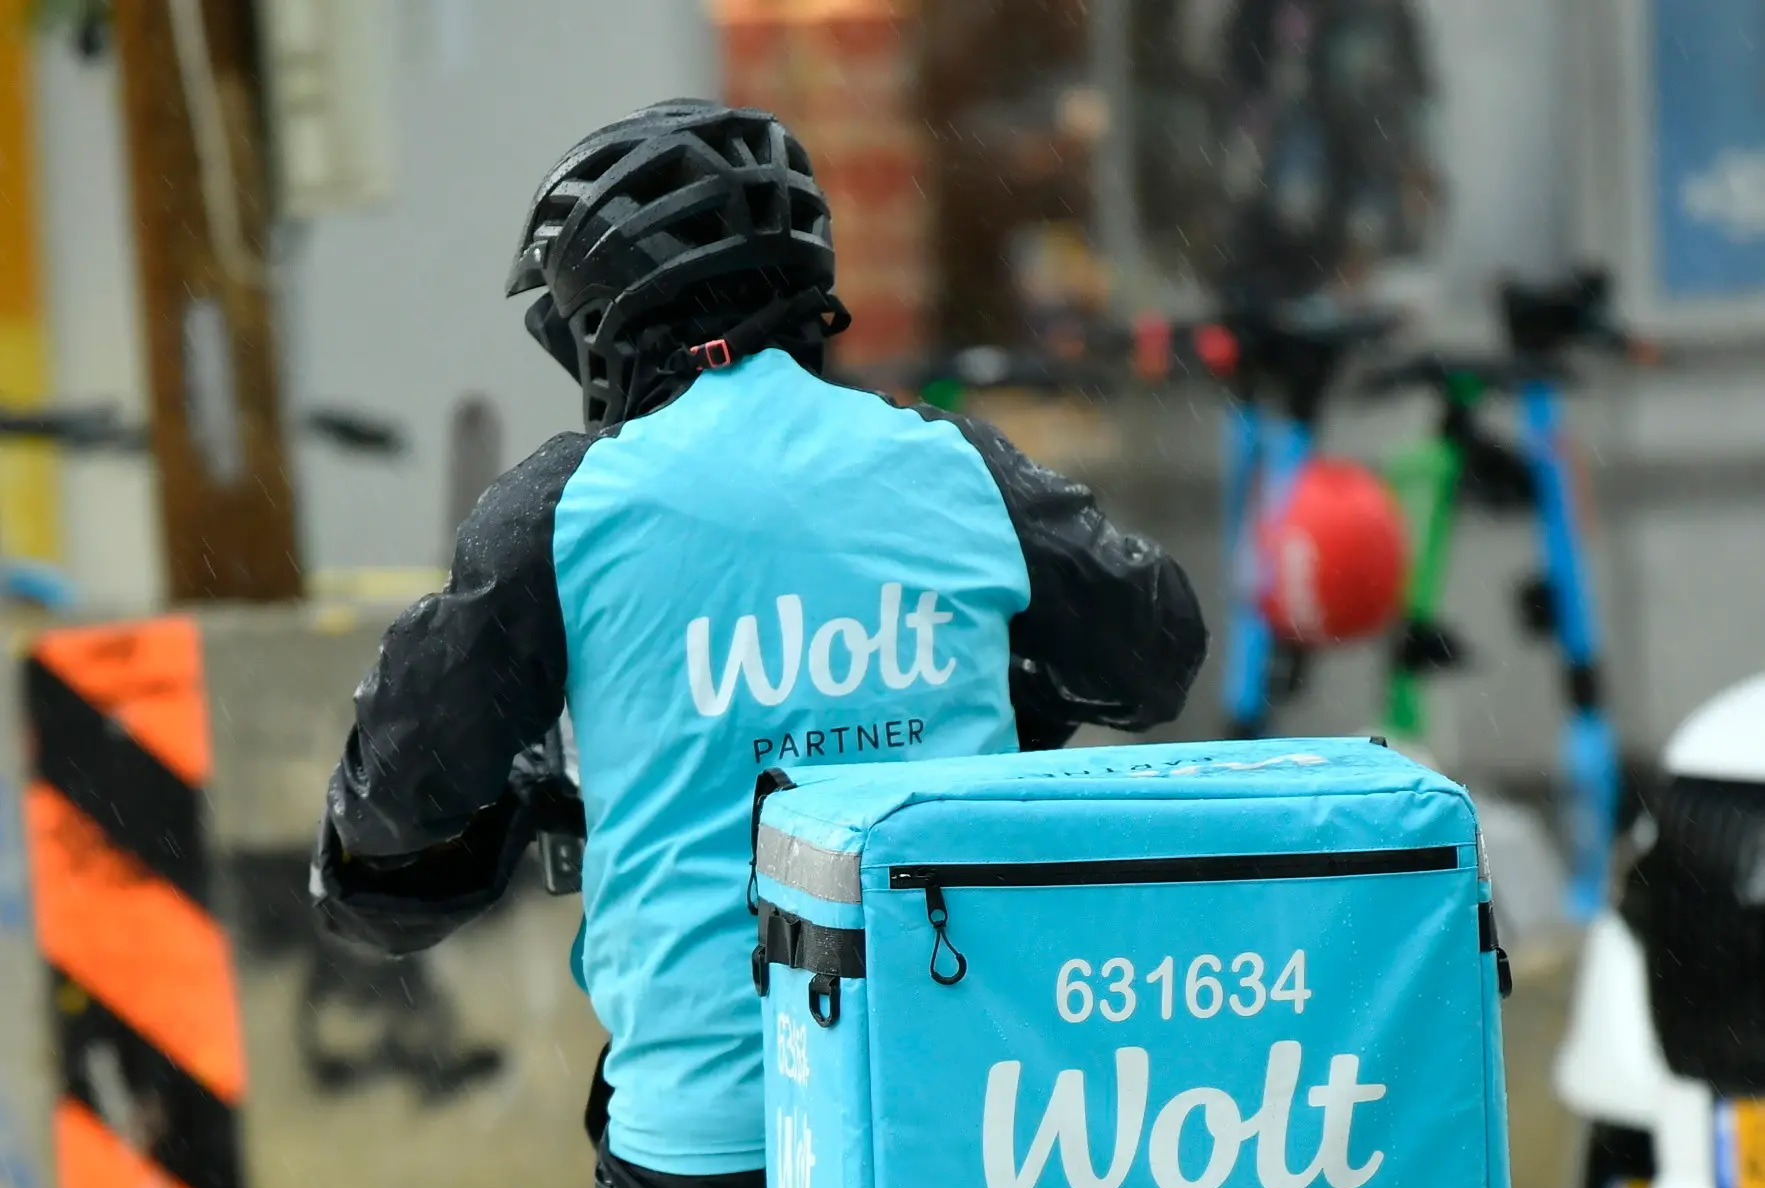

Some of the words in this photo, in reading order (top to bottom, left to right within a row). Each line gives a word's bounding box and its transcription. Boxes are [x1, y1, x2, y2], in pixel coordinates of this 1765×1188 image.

[687, 582, 957, 717] Wolt
[752, 719, 925, 764] PARTNER
[1056, 949, 1312, 1023] 631634
